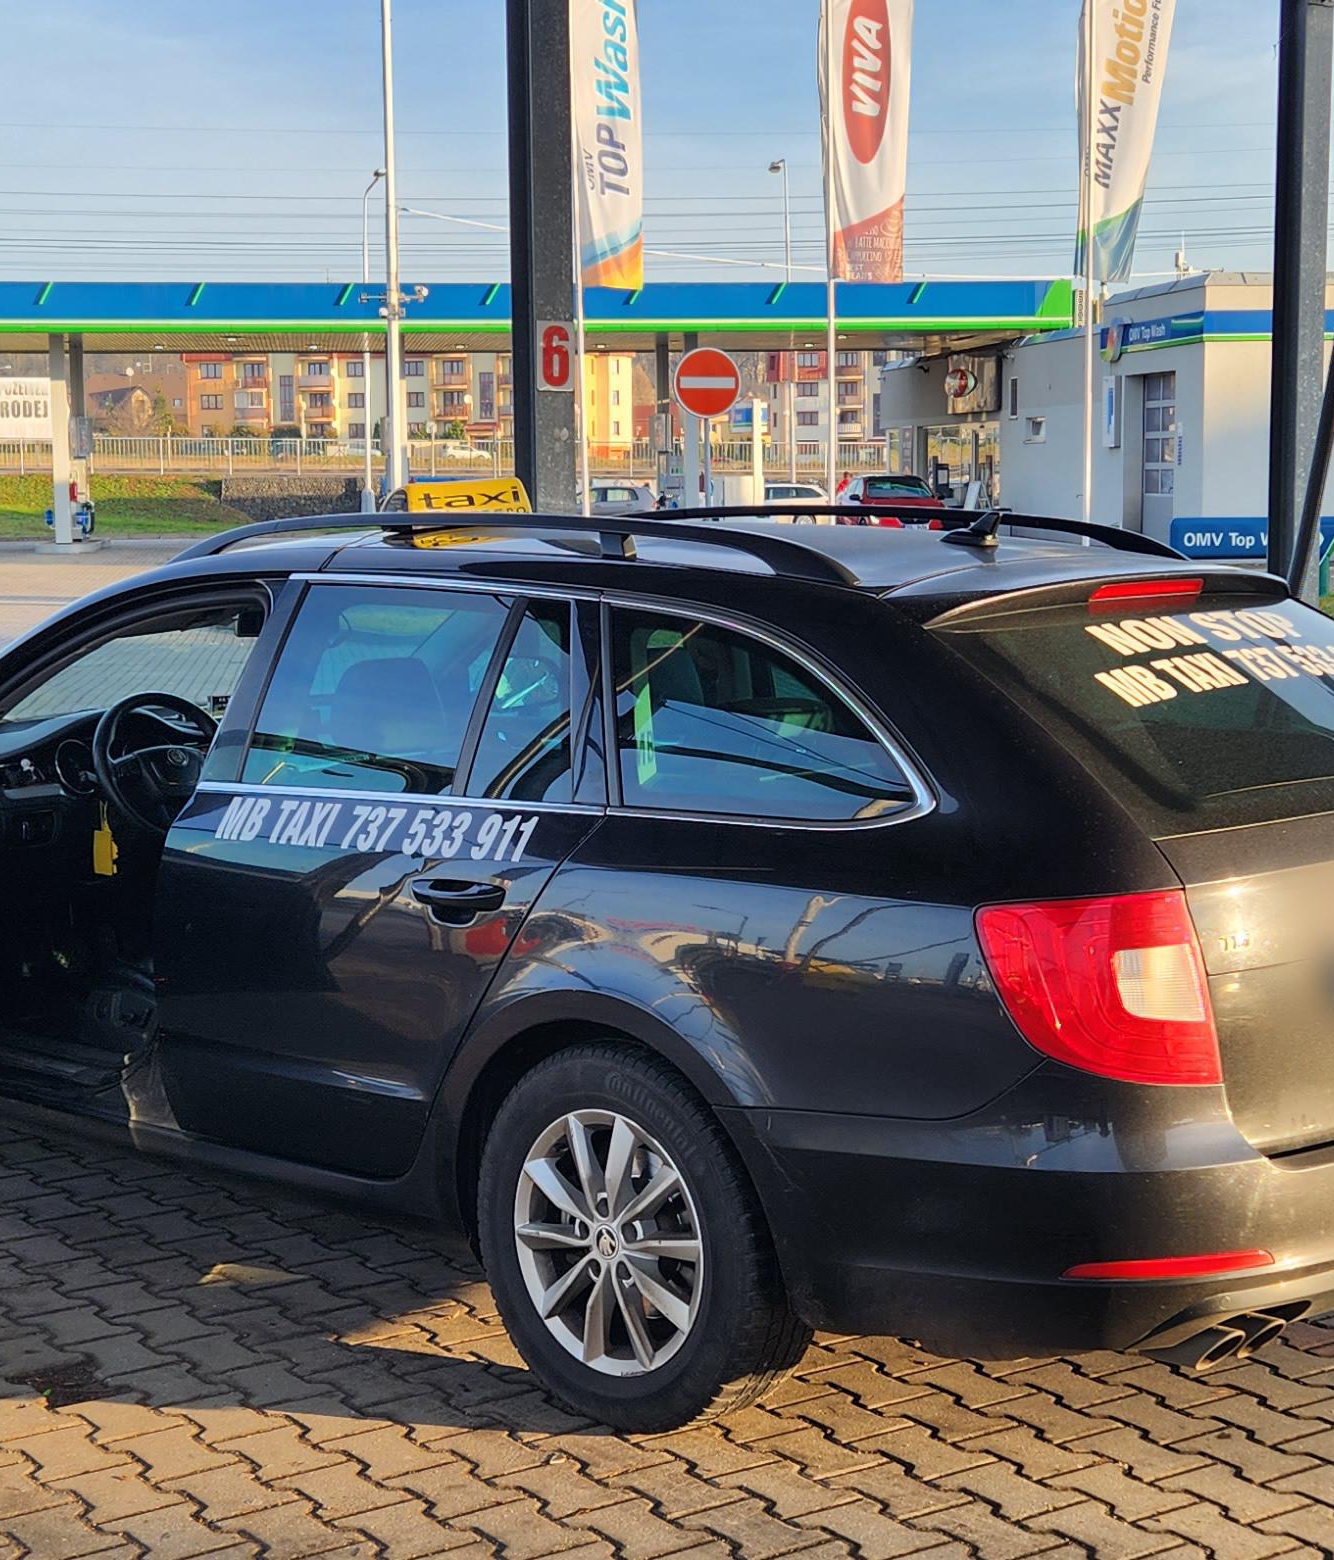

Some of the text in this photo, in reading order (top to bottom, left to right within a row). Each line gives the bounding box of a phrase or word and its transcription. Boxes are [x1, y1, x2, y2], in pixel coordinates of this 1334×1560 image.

[849, 15, 884, 118] VIVA
[1141, 12, 1160, 85] Performance
[596, 122, 631, 196] TOP
[1093, 98, 1122, 190] MAXX
[542, 325, 570, 387] 6
[418, 486, 521, 509] taxi
[1183, 531, 1224, 547] OMV
[1228, 532, 1255, 549] Top
[1084, 610, 1302, 656] NON STOP
[1093, 664, 1178, 708] MB
[1149, 652, 1250, 693] TAXI
[1221, 646, 1300, 681] 737
[214, 796, 540, 863] MB TAXI 737 533 911
[605, 1070, 698, 1158] Continental
